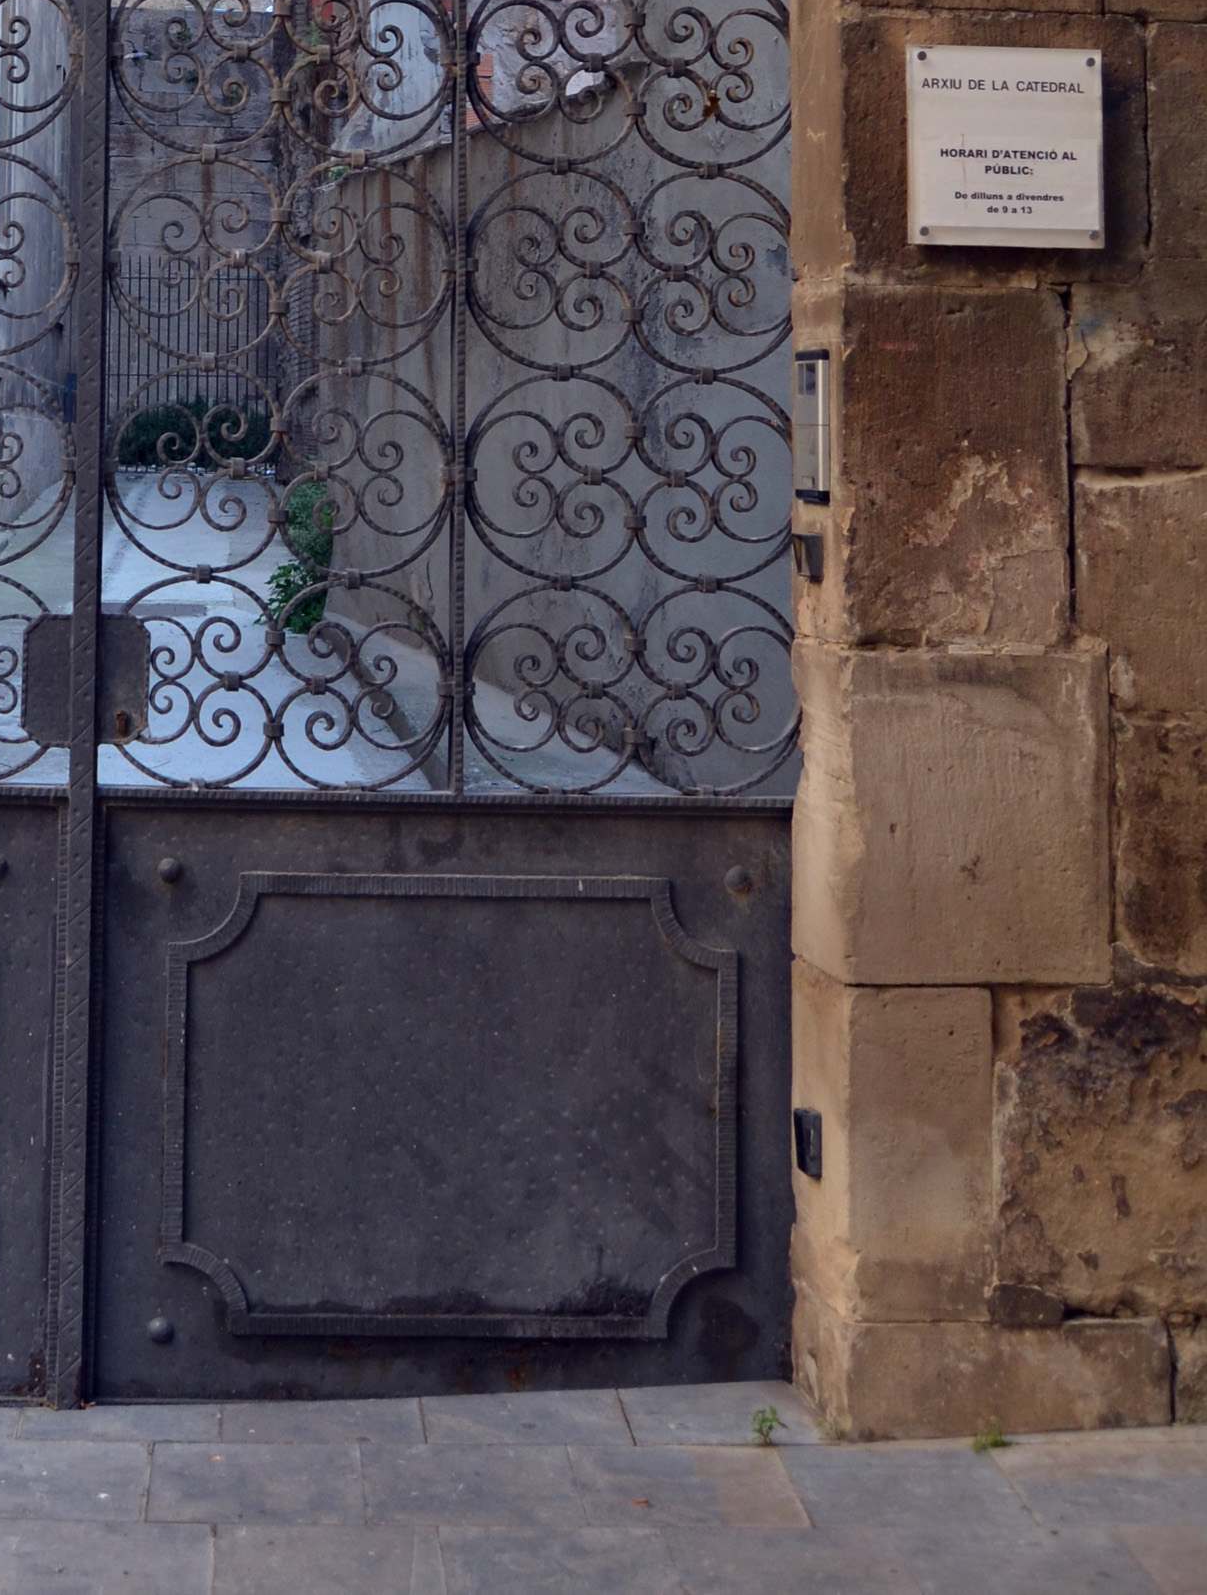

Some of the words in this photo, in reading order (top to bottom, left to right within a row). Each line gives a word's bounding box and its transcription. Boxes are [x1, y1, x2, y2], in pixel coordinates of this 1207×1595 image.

[922, 79, 962, 90] ARXIU
[968, 80, 985, 90] DE
[992, 81, 1009, 91] LA
[1016, 81, 1084, 93] CATEDRAL
[940, 149, 987, 158] HORARI
[992, 148, 1057, 160] D'ATENCIÓ
[1062, 151, 1077, 160] AL
[985, 163, 1033, 175] PÚBLIC:
[971, 192, 1003, 200] dilluns
[1016, 193, 1064, 202] divendres
